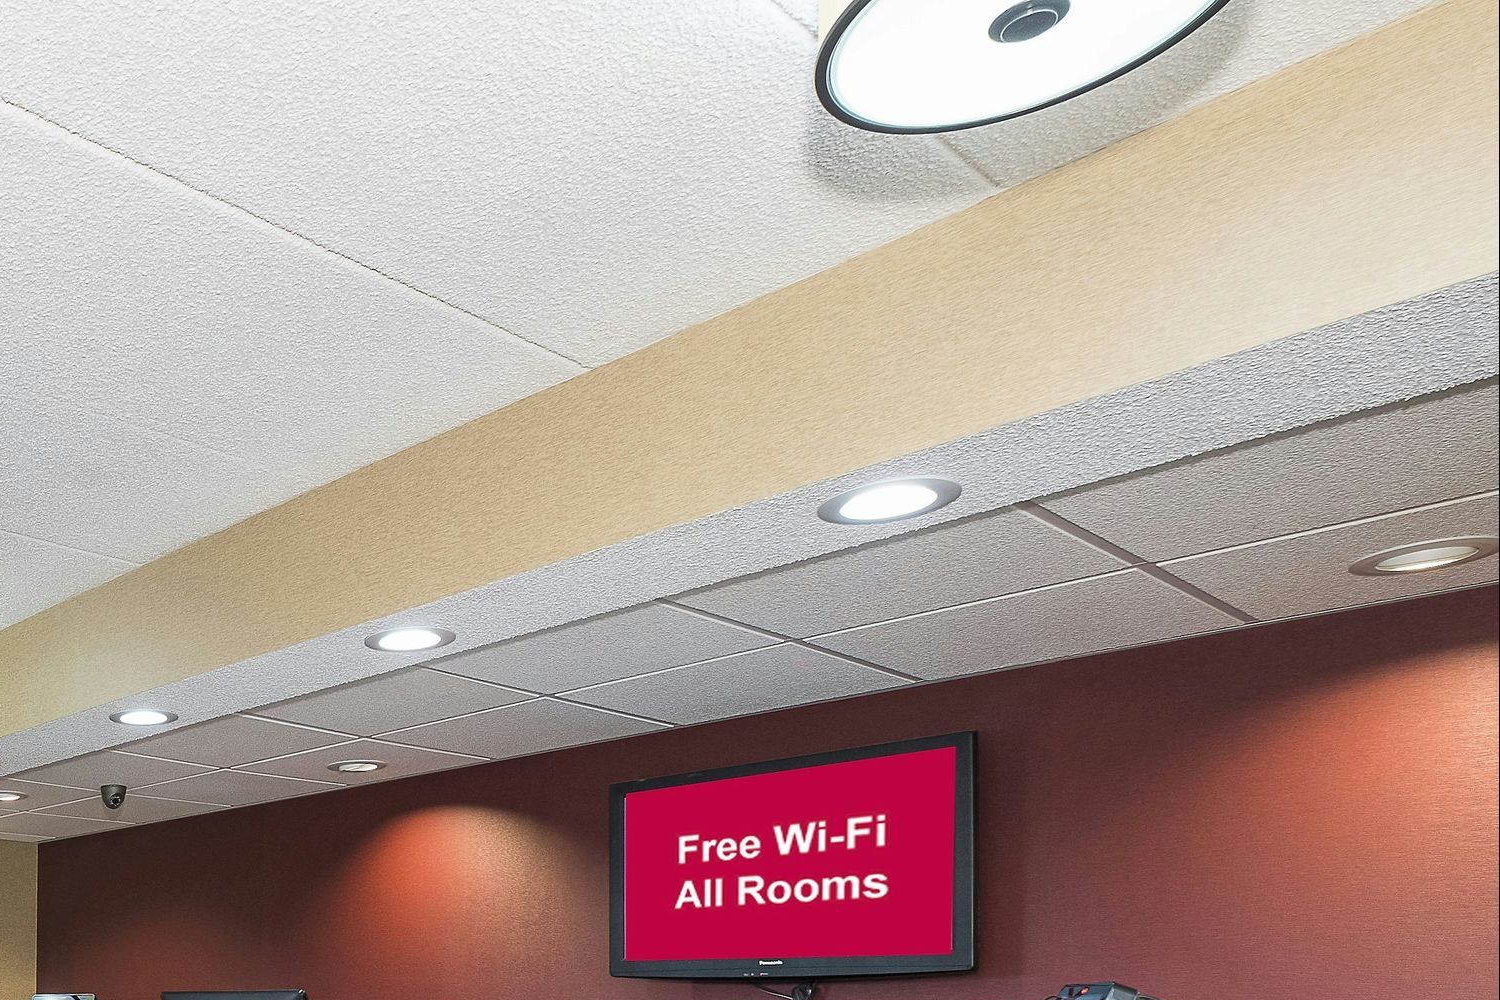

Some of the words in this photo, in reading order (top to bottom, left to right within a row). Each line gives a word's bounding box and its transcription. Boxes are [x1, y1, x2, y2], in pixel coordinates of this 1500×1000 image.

[678, 834, 761, 865] Free
[773, 814, 887, 856] Wi-Fi
[674, 878, 723, 910] All
[737, 873, 889, 906] Rooms
